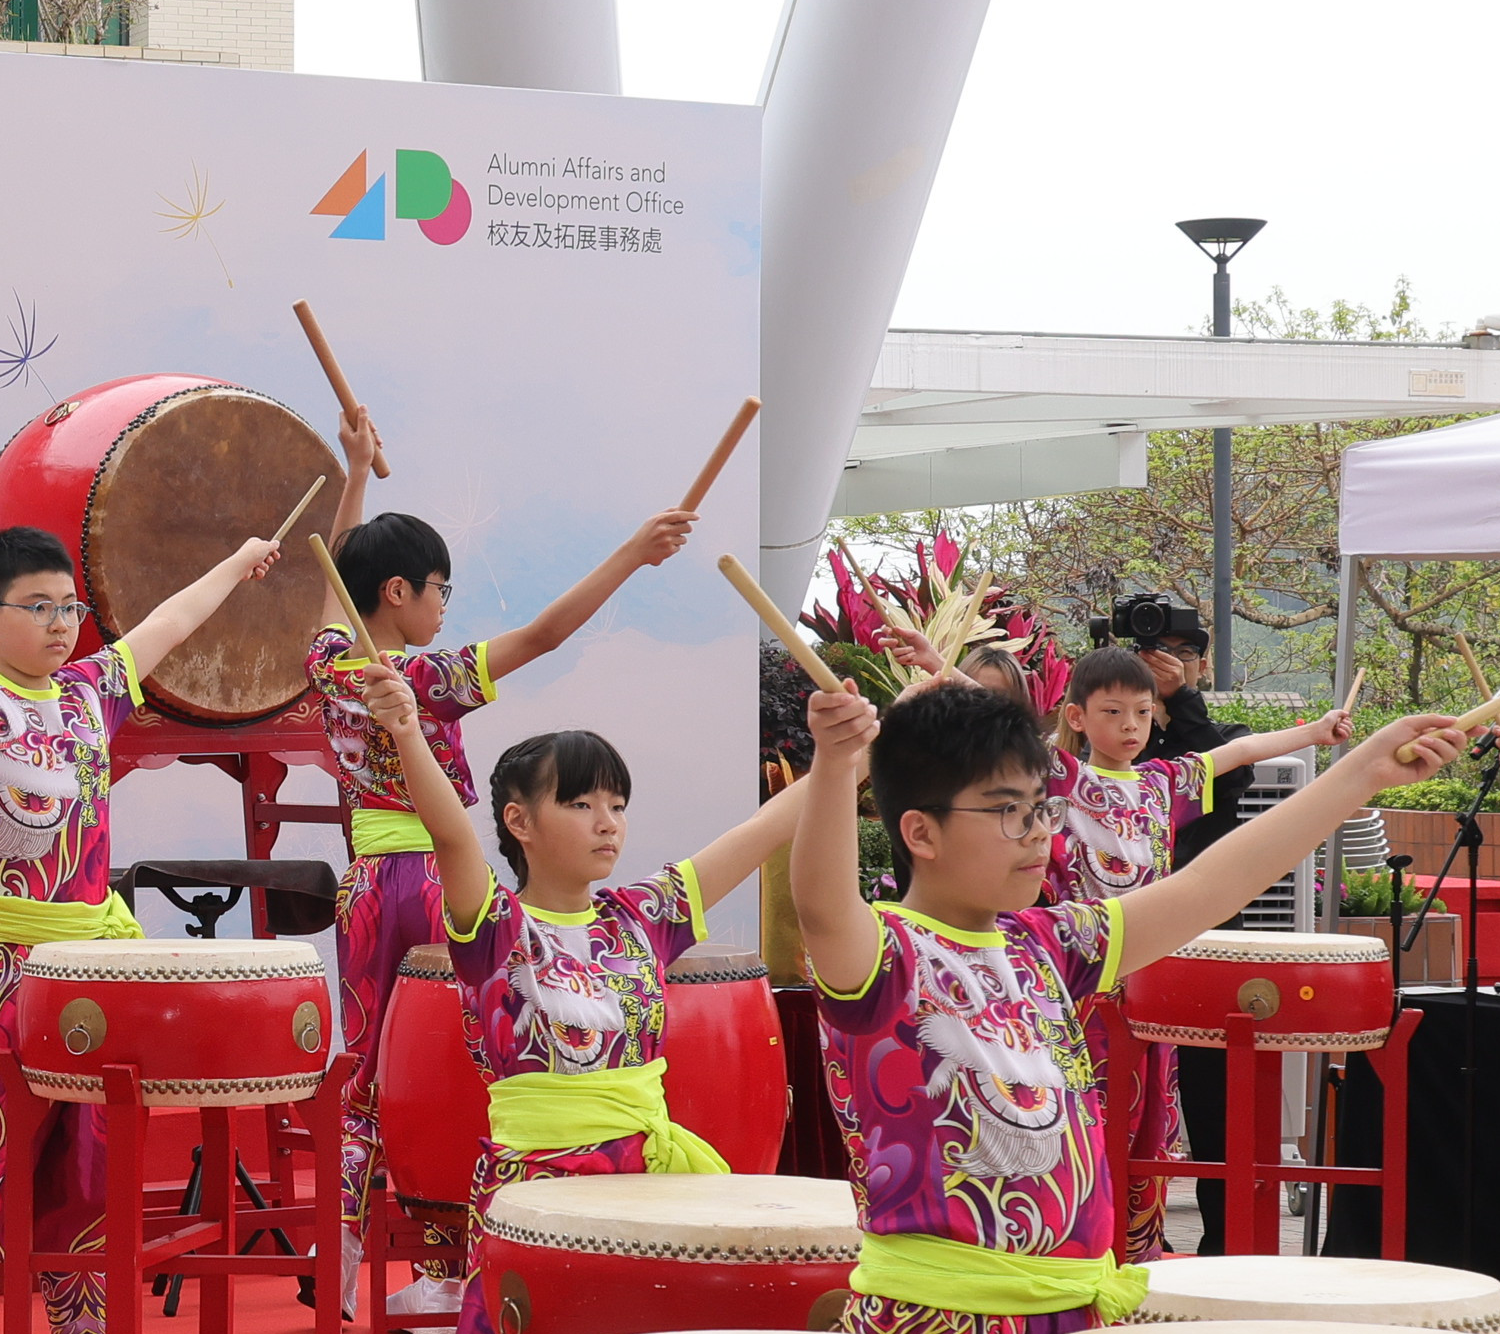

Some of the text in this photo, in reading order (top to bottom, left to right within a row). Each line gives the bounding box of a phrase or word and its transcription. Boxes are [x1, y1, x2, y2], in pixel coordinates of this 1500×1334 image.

[487, 153, 666, 184] Alumni Affairs and
[488, 184, 684, 215] Development Office
[487, 219, 662, 254] 校友及拓展事務處
